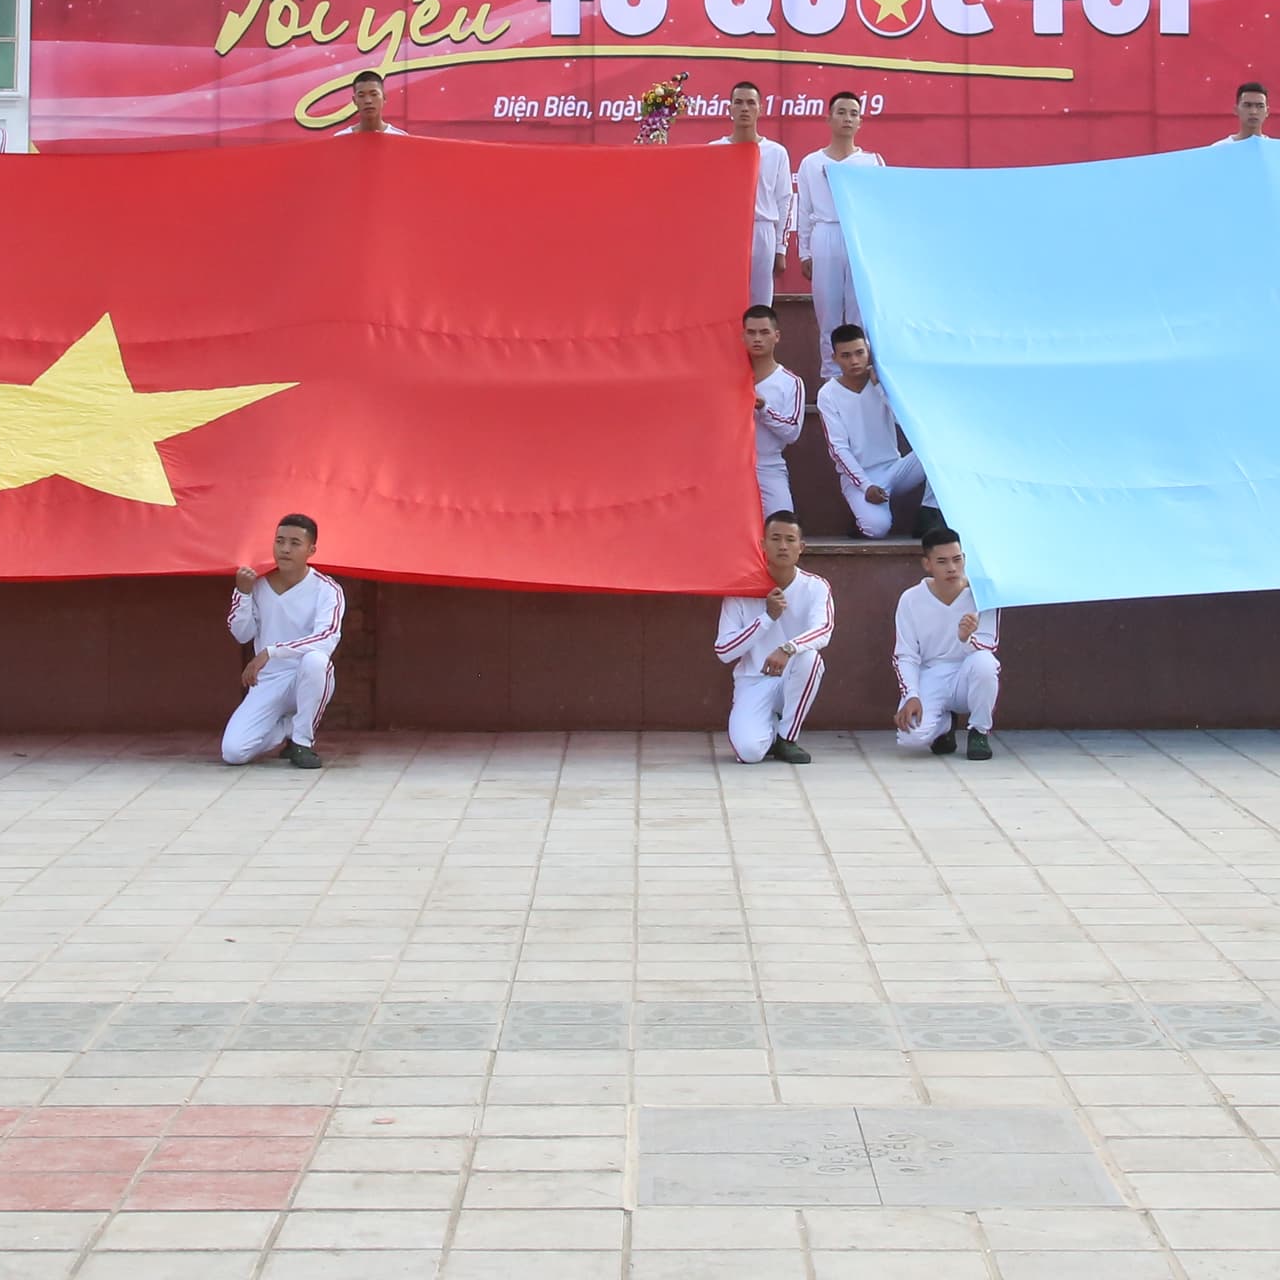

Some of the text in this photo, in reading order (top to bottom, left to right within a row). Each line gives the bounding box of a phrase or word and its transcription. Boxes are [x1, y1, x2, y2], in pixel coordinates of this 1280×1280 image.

[494, 95, 539, 122] Điện
[544, 96, 593, 119] Biên,
[686, 94, 734, 119] thán
[781, 94, 823, 116] năm
